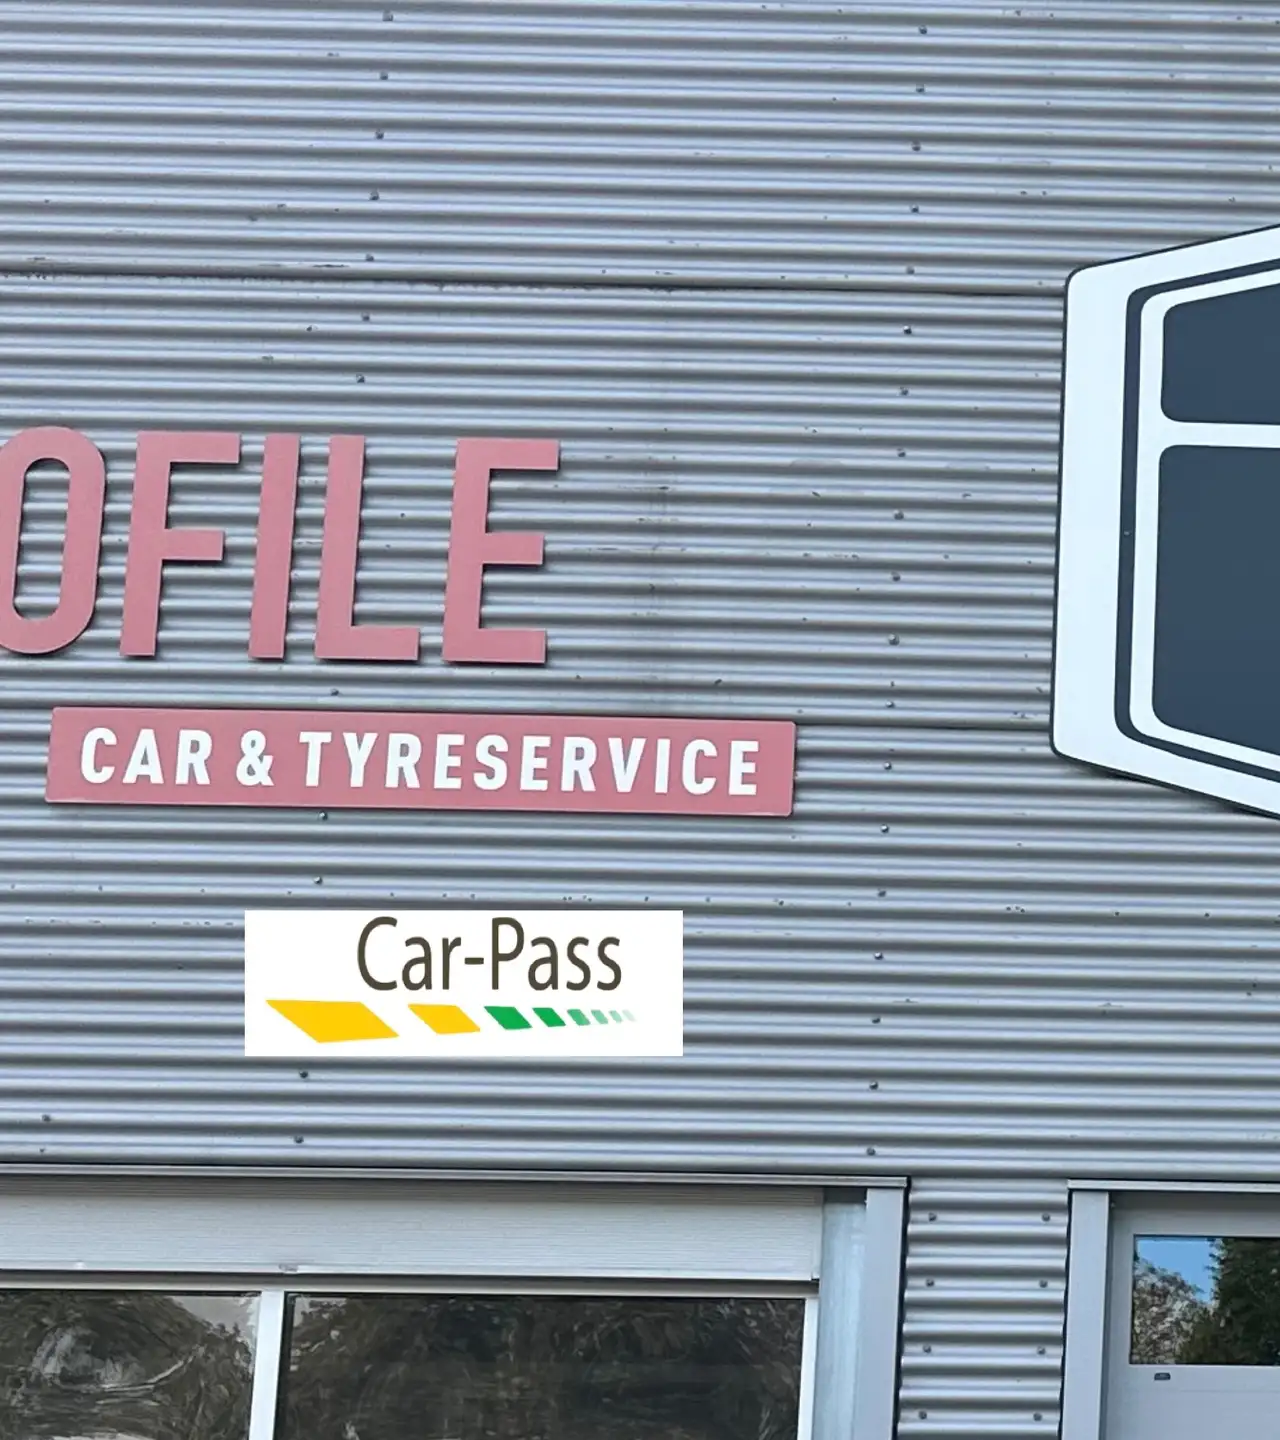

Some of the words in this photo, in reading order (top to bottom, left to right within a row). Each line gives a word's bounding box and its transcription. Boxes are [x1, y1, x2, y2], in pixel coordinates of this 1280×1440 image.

[80, 727, 213, 786] CAR
[235, 729, 275, 787] &
[298, 731, 760, 797] TYRESERVICE
